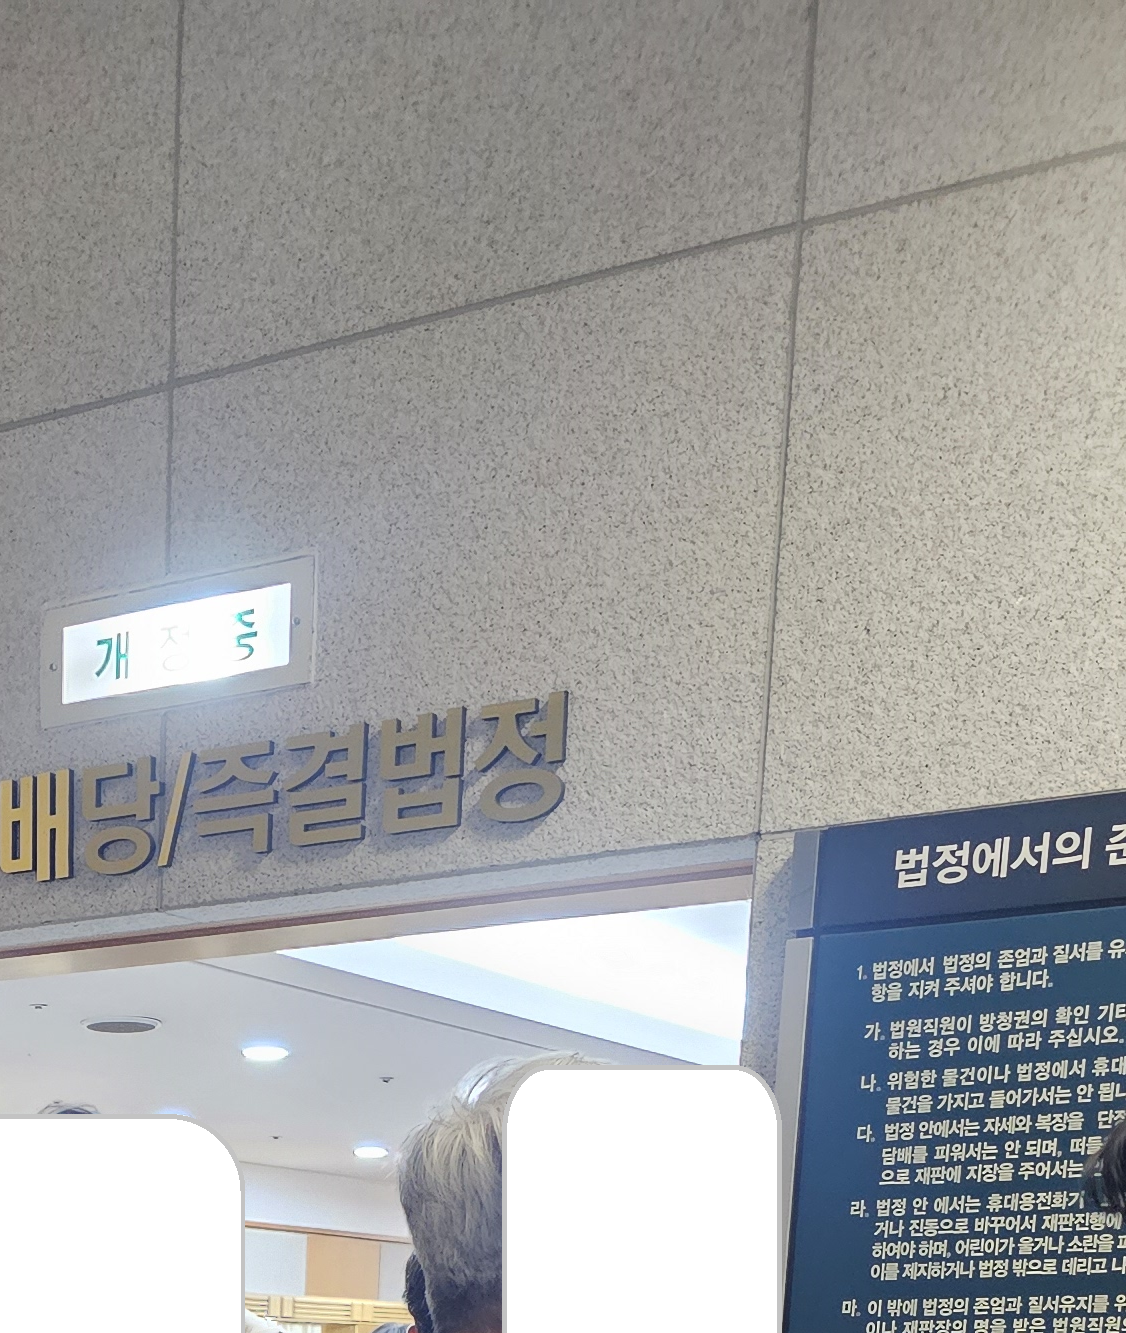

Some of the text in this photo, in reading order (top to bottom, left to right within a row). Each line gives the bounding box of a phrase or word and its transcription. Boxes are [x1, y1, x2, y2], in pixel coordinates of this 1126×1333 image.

[895, 827, 1092, 888] 법정에서의
[873, 957, 934, 980] 법정에서
[943, 952, 991, 973] 법정의
[997, 946, 1048, 967] 존엄과
[1053, 941, 1103, 964] 질서를
[1108, 939, 1126, 959] 유
[872, 967, 1053, 1002] 항을 지켜 주셔야 합니다.
[890, 1015, 972, 1038] 법원직원이
[979, 1009, 1048, 1031] 방청권의
[1055, 1005, 1089, 1025] 확인
[889, 1023, 1124, 1060] 하는 경우 이에 따라 주십시오.
[887, 1070, 937, 1090] 위험한
[942, 1064, 1011, 1087] 물건이나
[1017, 1059, 1086, 1081] 법정에서
[886, 1095, 933, 1115] 물건을
[937, 1092, 984, 1111] 가지고
[989, 1086, 1072, 1108] 들어가서는
[1077, 1084, 1094, 1102] 안
[885, 1122, 914, 1141] 법정
[919, 1119, 980, 1139] 안에서는
[983, 1115, 1032, 1135] 자세와
[1035, 1112, 1084, 1132] 복장을
[882, 1146, 928, 1165] 담배를
[934, 1142, 998, 1164] 피워서는
[1005, 1140, 1021, 1158] 안
[1025, 1138, 1062, 1157] 되며,
[879, 1169, 910, 1185] 으로
[914, 1165, 961, 1185] 재판에
[966, 1163, 1014, 1182] 지장을
[1018, 1160, 1085, 1180] 주어서는
[877, 1198, 906, 1217] 법정
[913, 1197, 928, 1215] 안
[934, 1195, 981, 1214] 에서는
[874, 1212, 1122, 1238] 거나 진동으로 바꾸어서 재판진행에
[872, 1241, 916, 1259] 하여야
[919, 1240, 951, 1258] 하며,
[955, 1237, 1015, 1256] 어린이가
[1018, 1236, 1064, 1254] 울거나
[1066, 1234, 1114, 1252] 소란을
[871, 1263, 899, 1280] 이를
[902, 1260, 975, 1280] 제지하거나
[979, 1259, 1009, 1278] 법정
[1012, 1259, 1057, 1277] 밖으로
[1062, 1257, 1107, 1275] 데리고
[868, 1300, 882, 1317] 이
[887, 1299, 918, 1316] 밖에
[923, 1298, 969, 1316] 법정의
[973, 1296, 1022, 1315] 존엄과
[1029, 1295, 1109, 1314] 질서유지를
